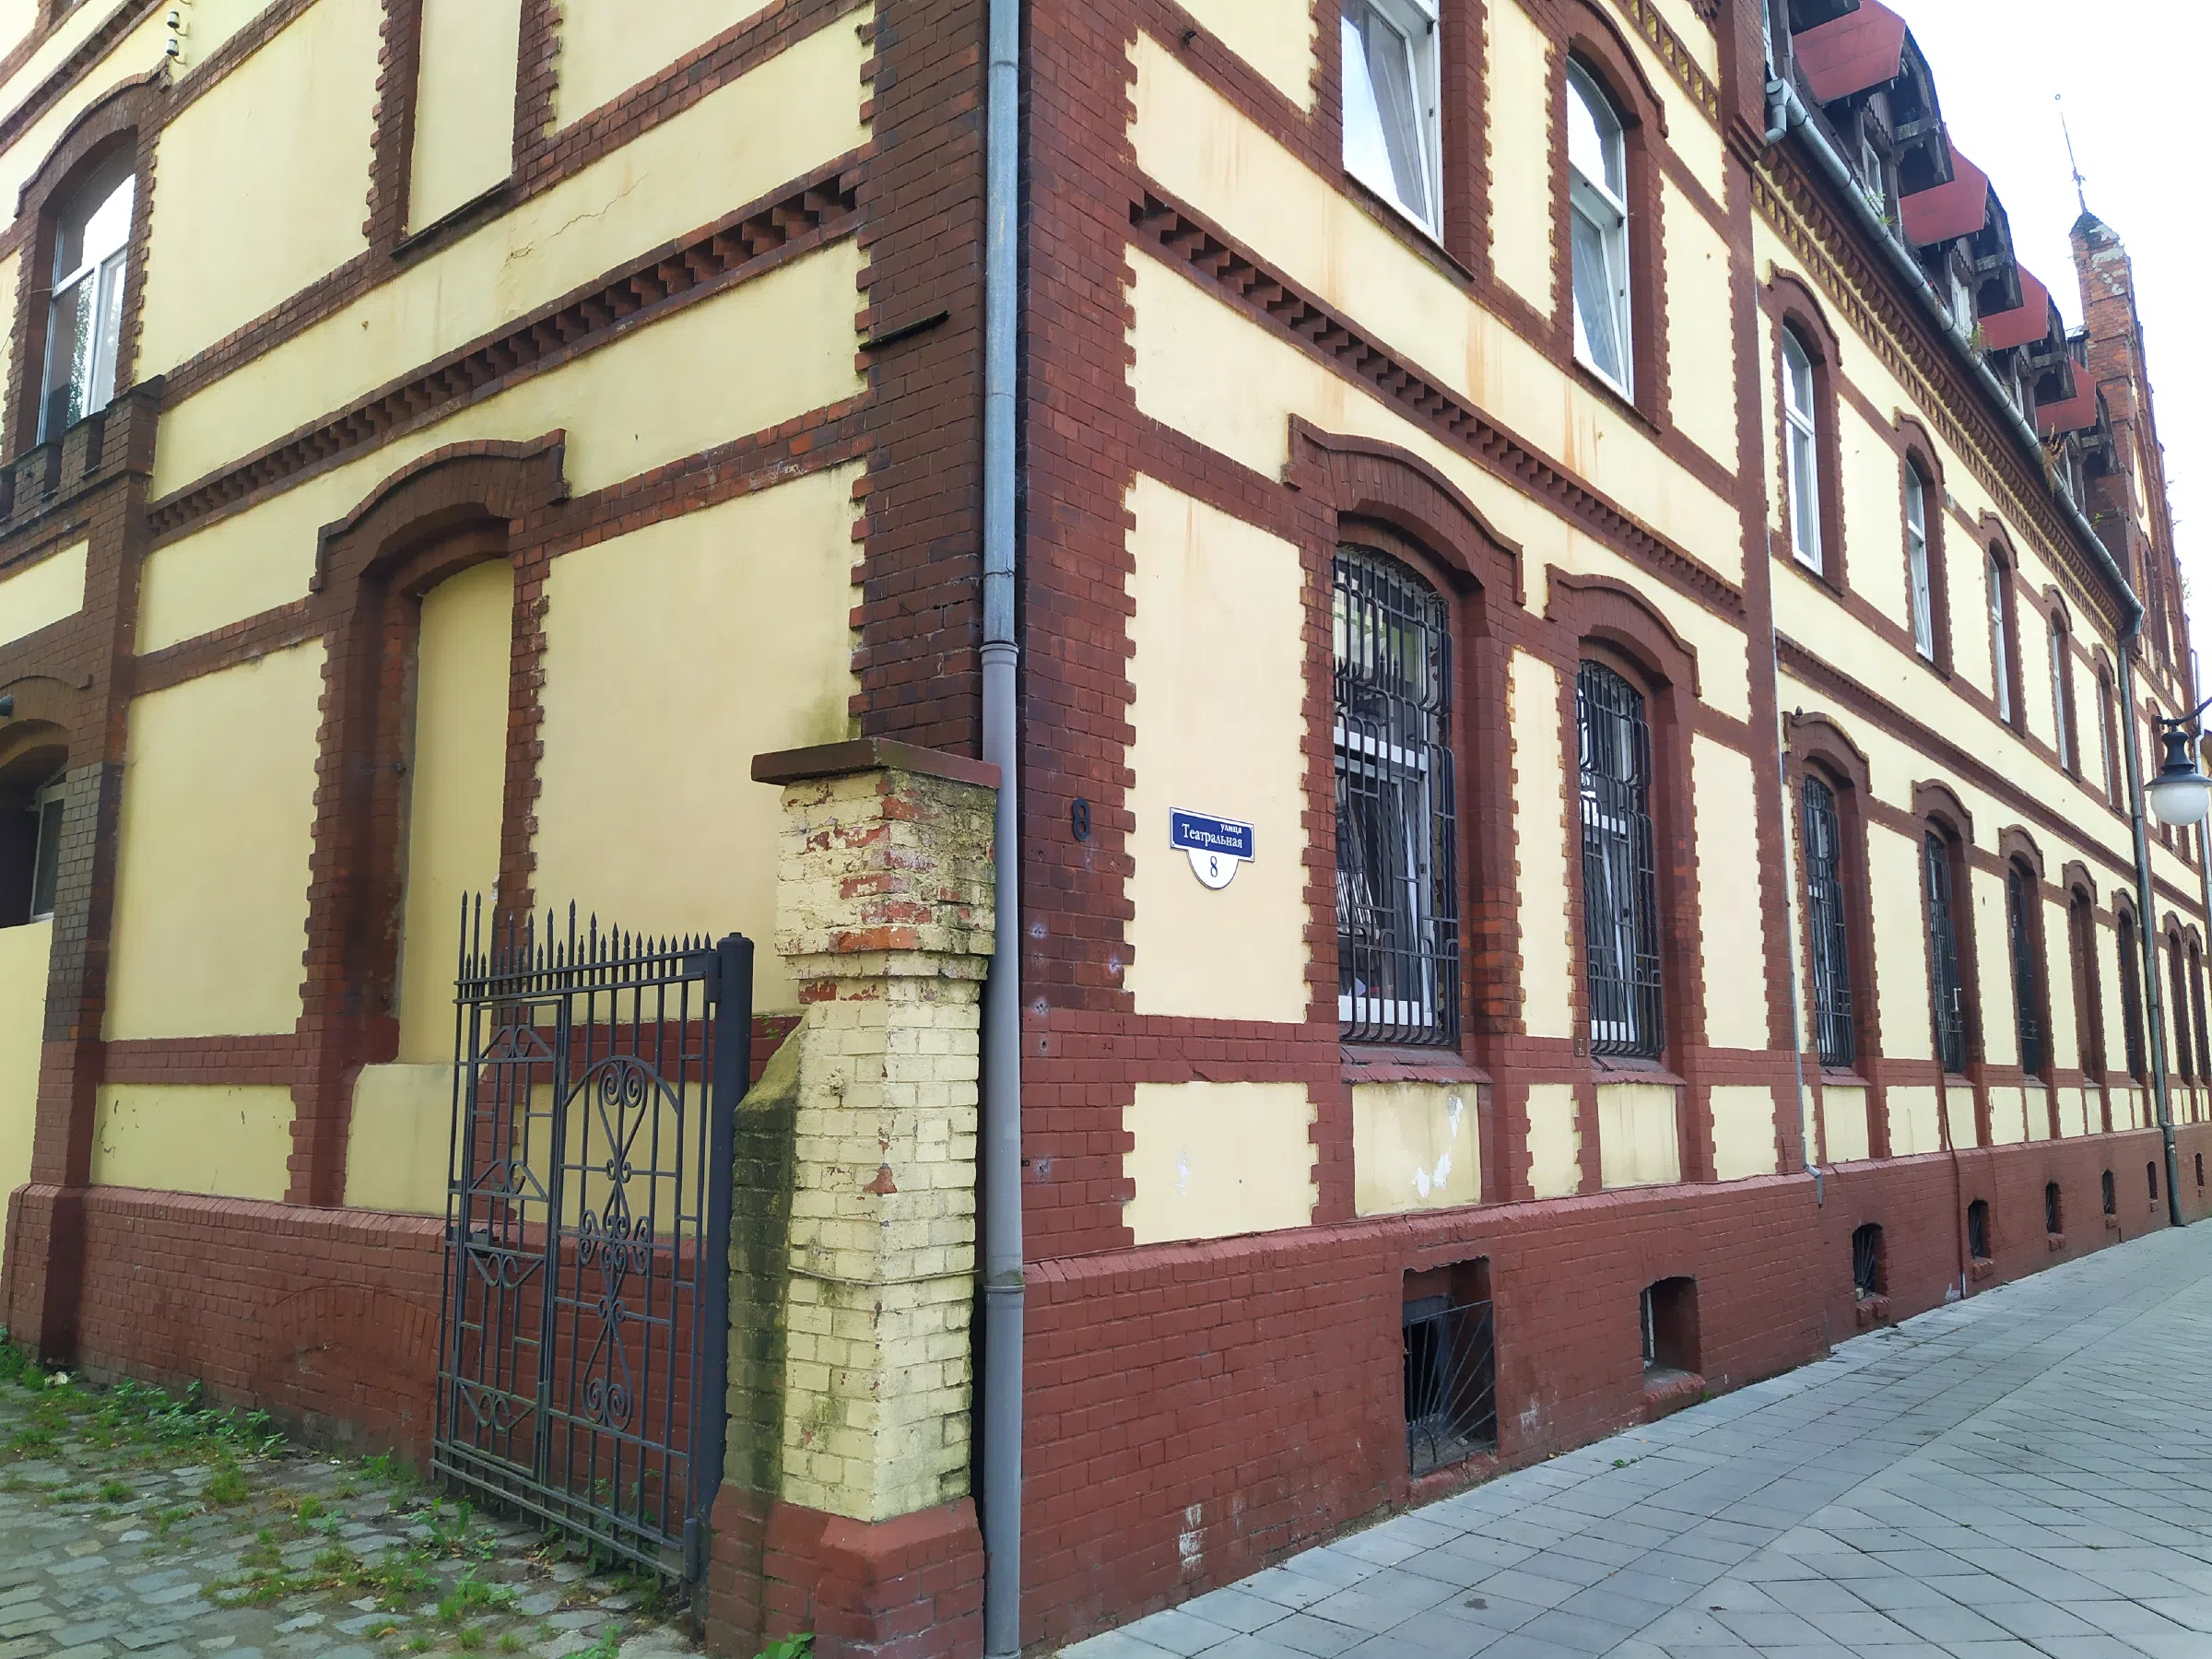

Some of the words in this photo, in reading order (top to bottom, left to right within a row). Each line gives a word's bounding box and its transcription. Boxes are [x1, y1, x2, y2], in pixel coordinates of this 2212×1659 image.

[1072, 796, 1090, 841] 8
[1220, 823, 1242, 835] улица
[1182, 822, 1242, 848] Театральная
[1210, 855, 1218, 877] 8
